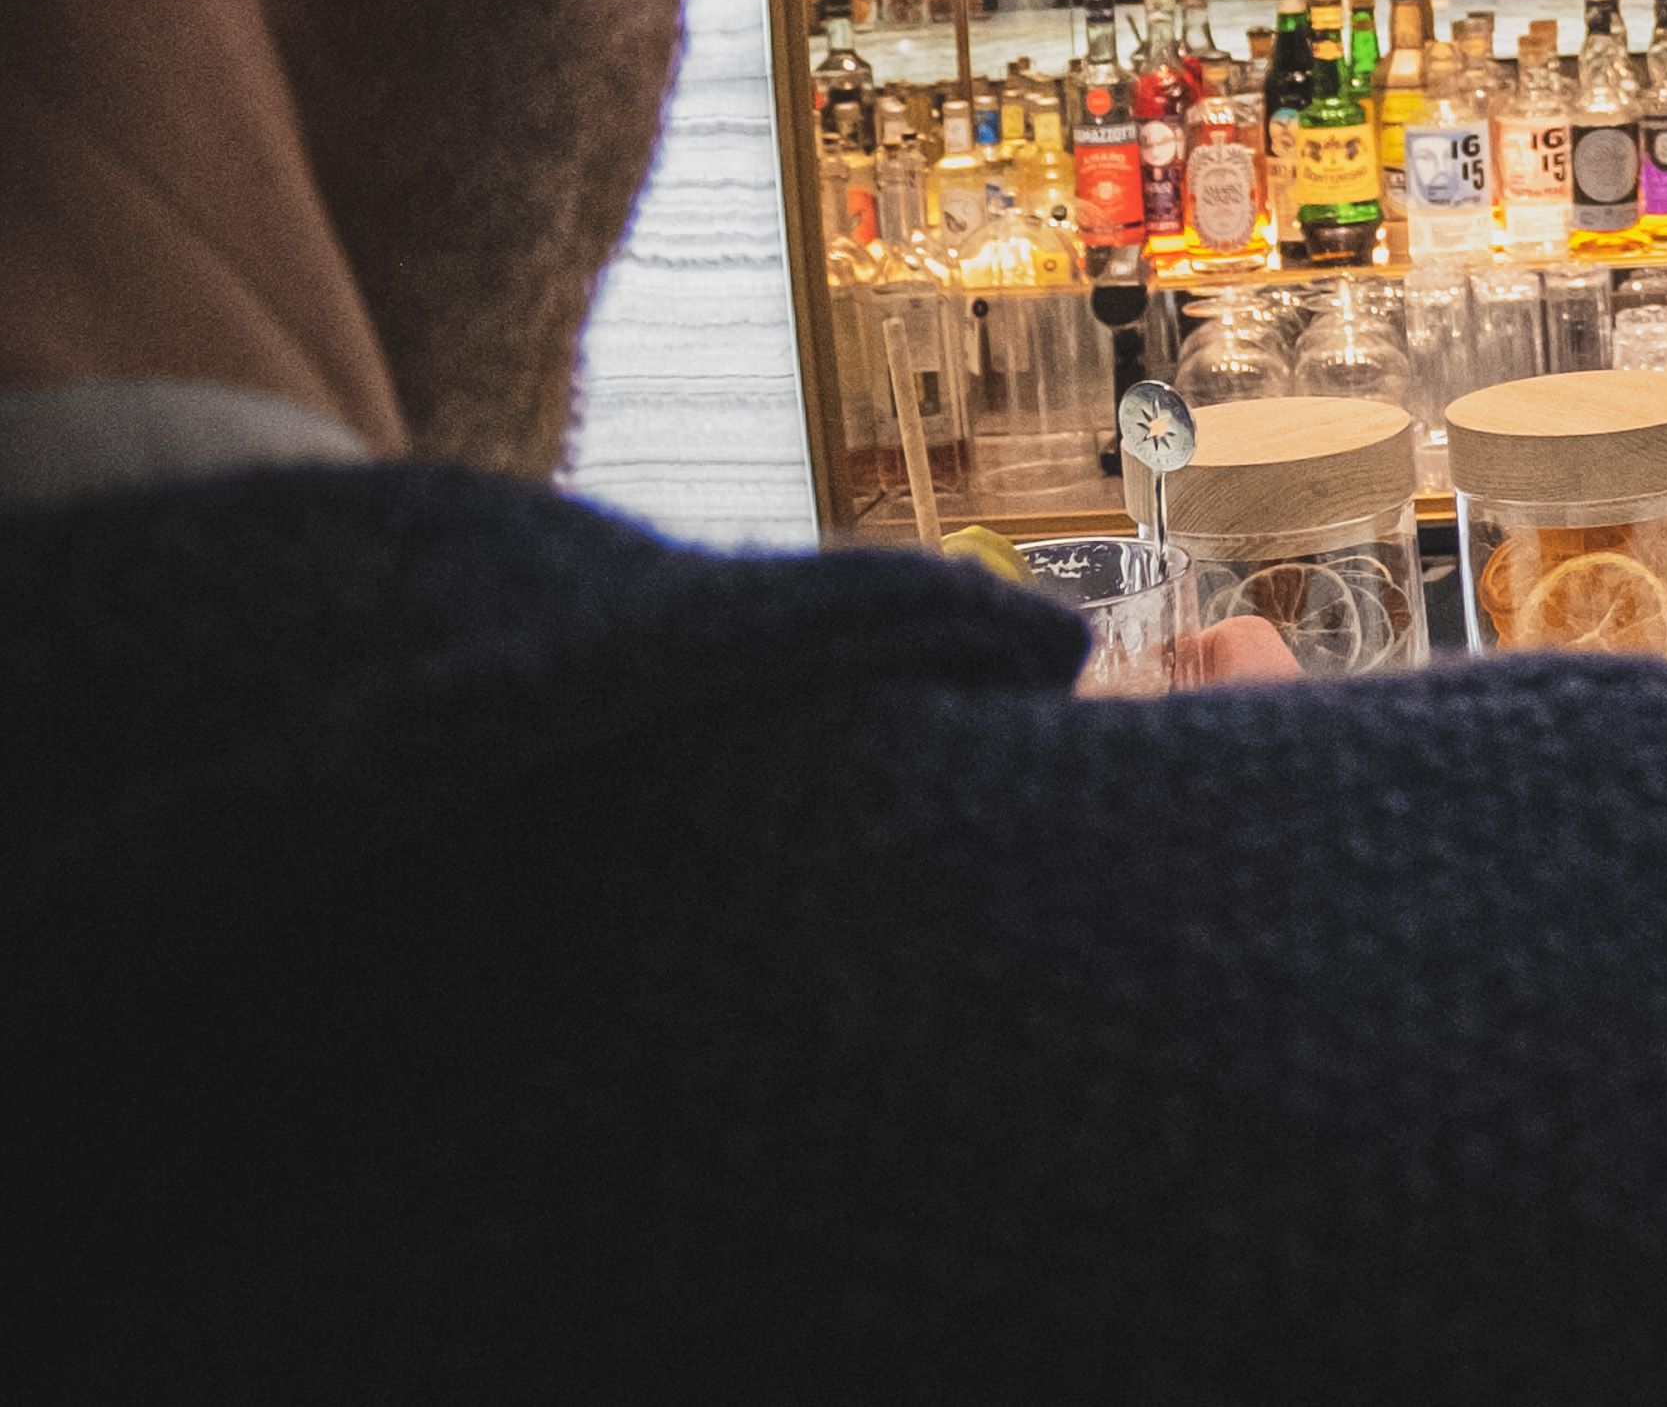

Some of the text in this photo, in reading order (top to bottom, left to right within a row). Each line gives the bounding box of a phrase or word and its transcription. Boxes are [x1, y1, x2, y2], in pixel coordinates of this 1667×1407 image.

[1449, 134, 1481, 161] 16
[1530, 128, 1566, 152] 16
[1461, 158, 1485, 192] 15
[1541, 152, 1567, 184] 15
